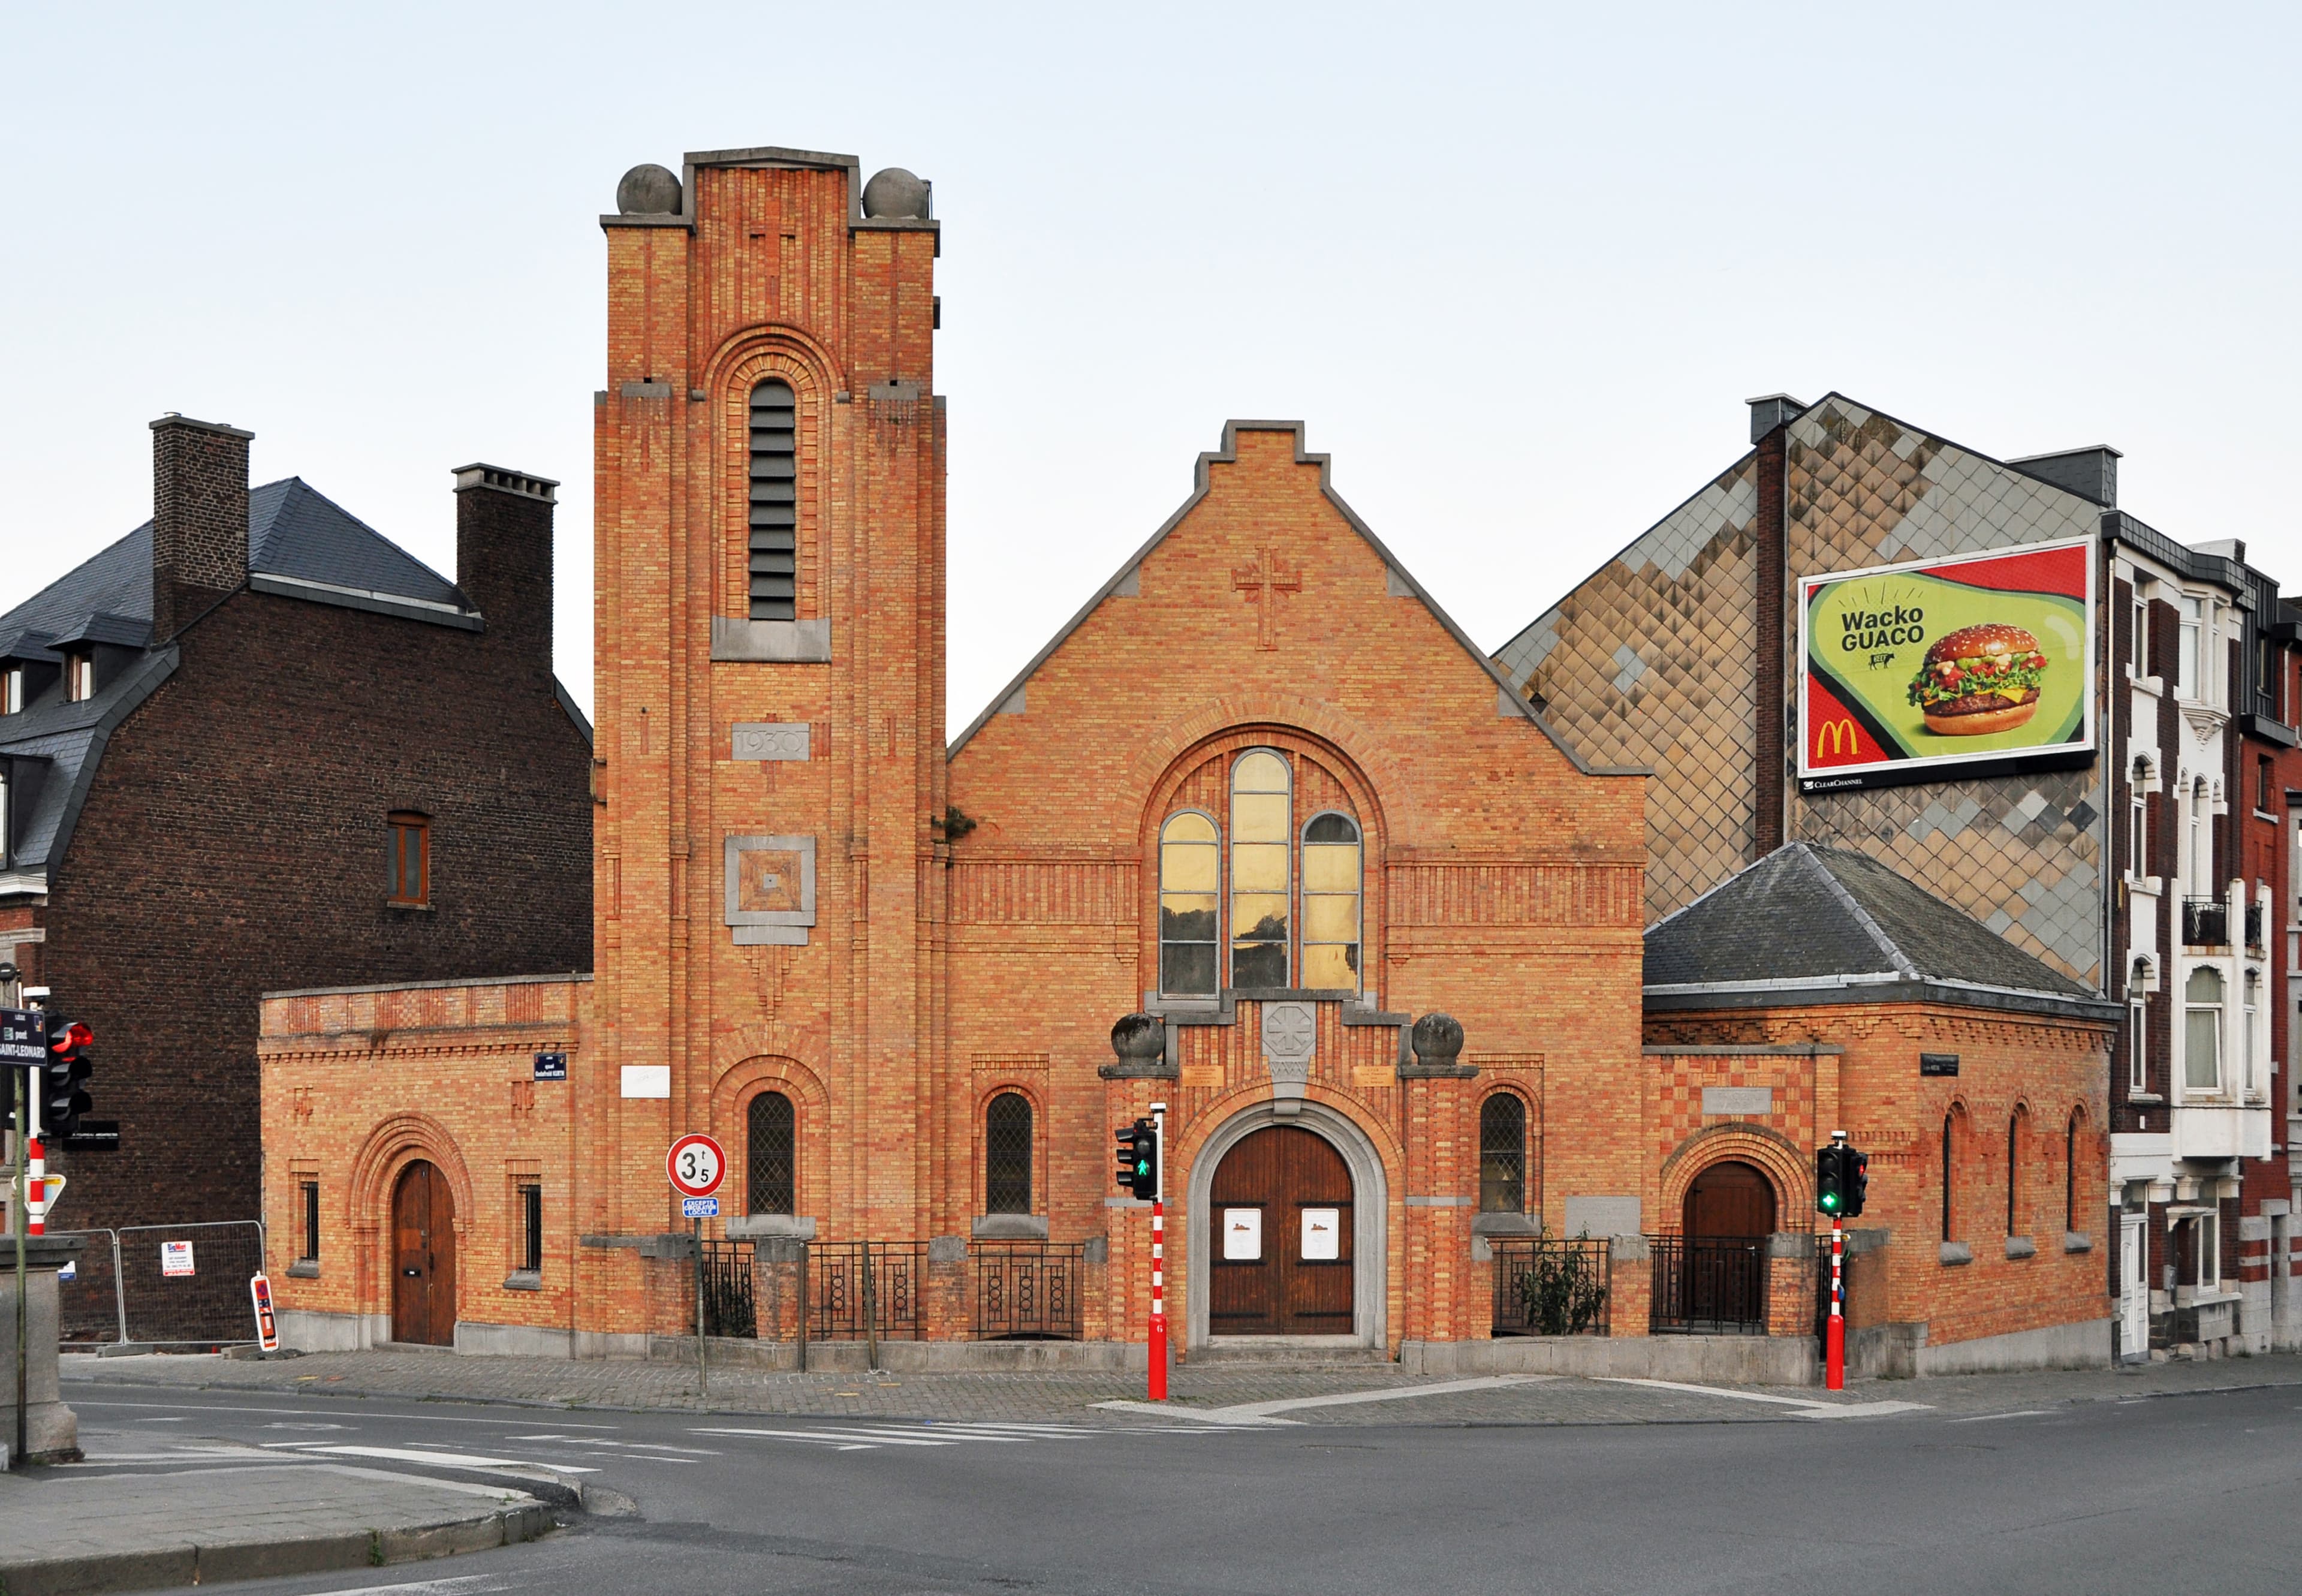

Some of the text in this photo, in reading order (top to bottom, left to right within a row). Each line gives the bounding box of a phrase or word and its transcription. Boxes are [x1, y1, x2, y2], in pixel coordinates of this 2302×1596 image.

[1842, 605, 1923, 631] Wacko
[1842, 625, 1924, 652] GUACO
[736, 725, 803, 752] 1930
